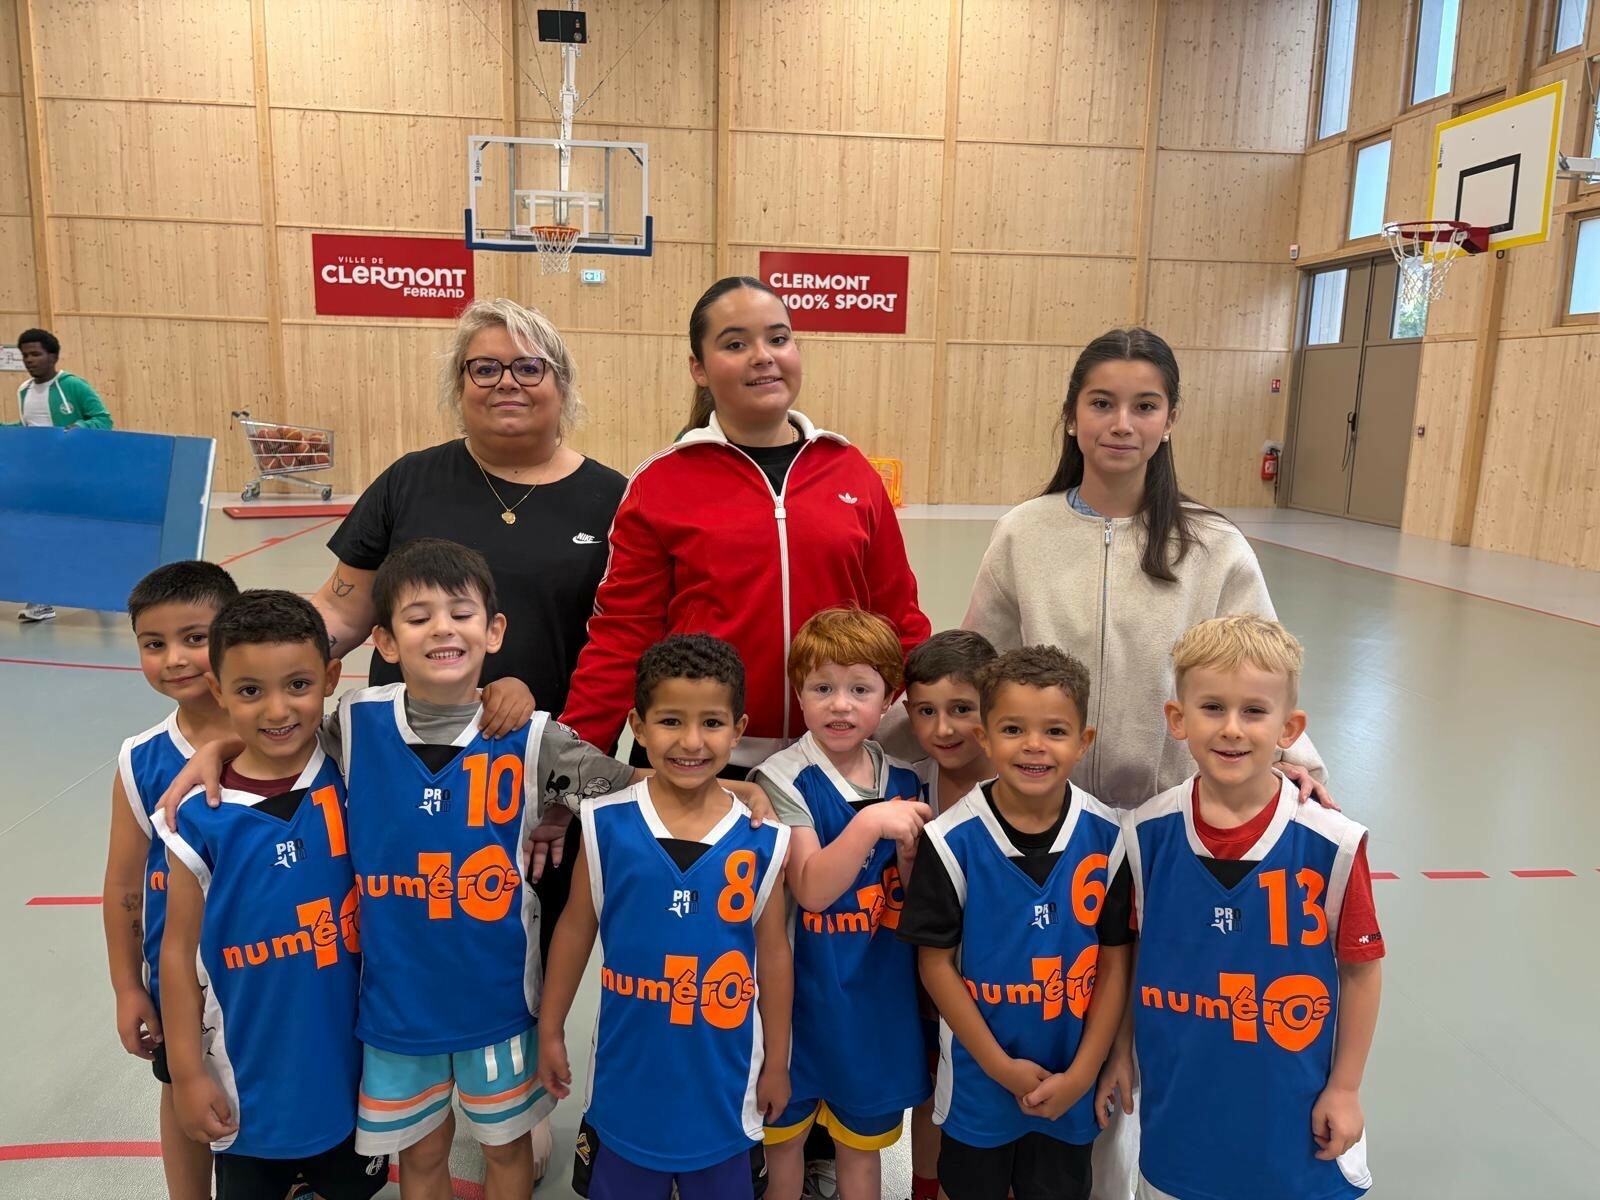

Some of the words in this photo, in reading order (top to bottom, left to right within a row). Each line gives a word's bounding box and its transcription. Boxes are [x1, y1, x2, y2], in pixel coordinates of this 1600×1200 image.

[338, 256, 366, 264] VILLE
[371, 257, 384, 265] DE
[769, 272, 871, 291] CLERMONT
[782, 293, 830, 310] 100%
[834, 294, 898, 313] SPORT
[462, 752, 524, 827] 10
[717, 849, 757, 923] 8
[1071, 853, 1109, 926] 6
[1258, 867, 1328, 946] 13
